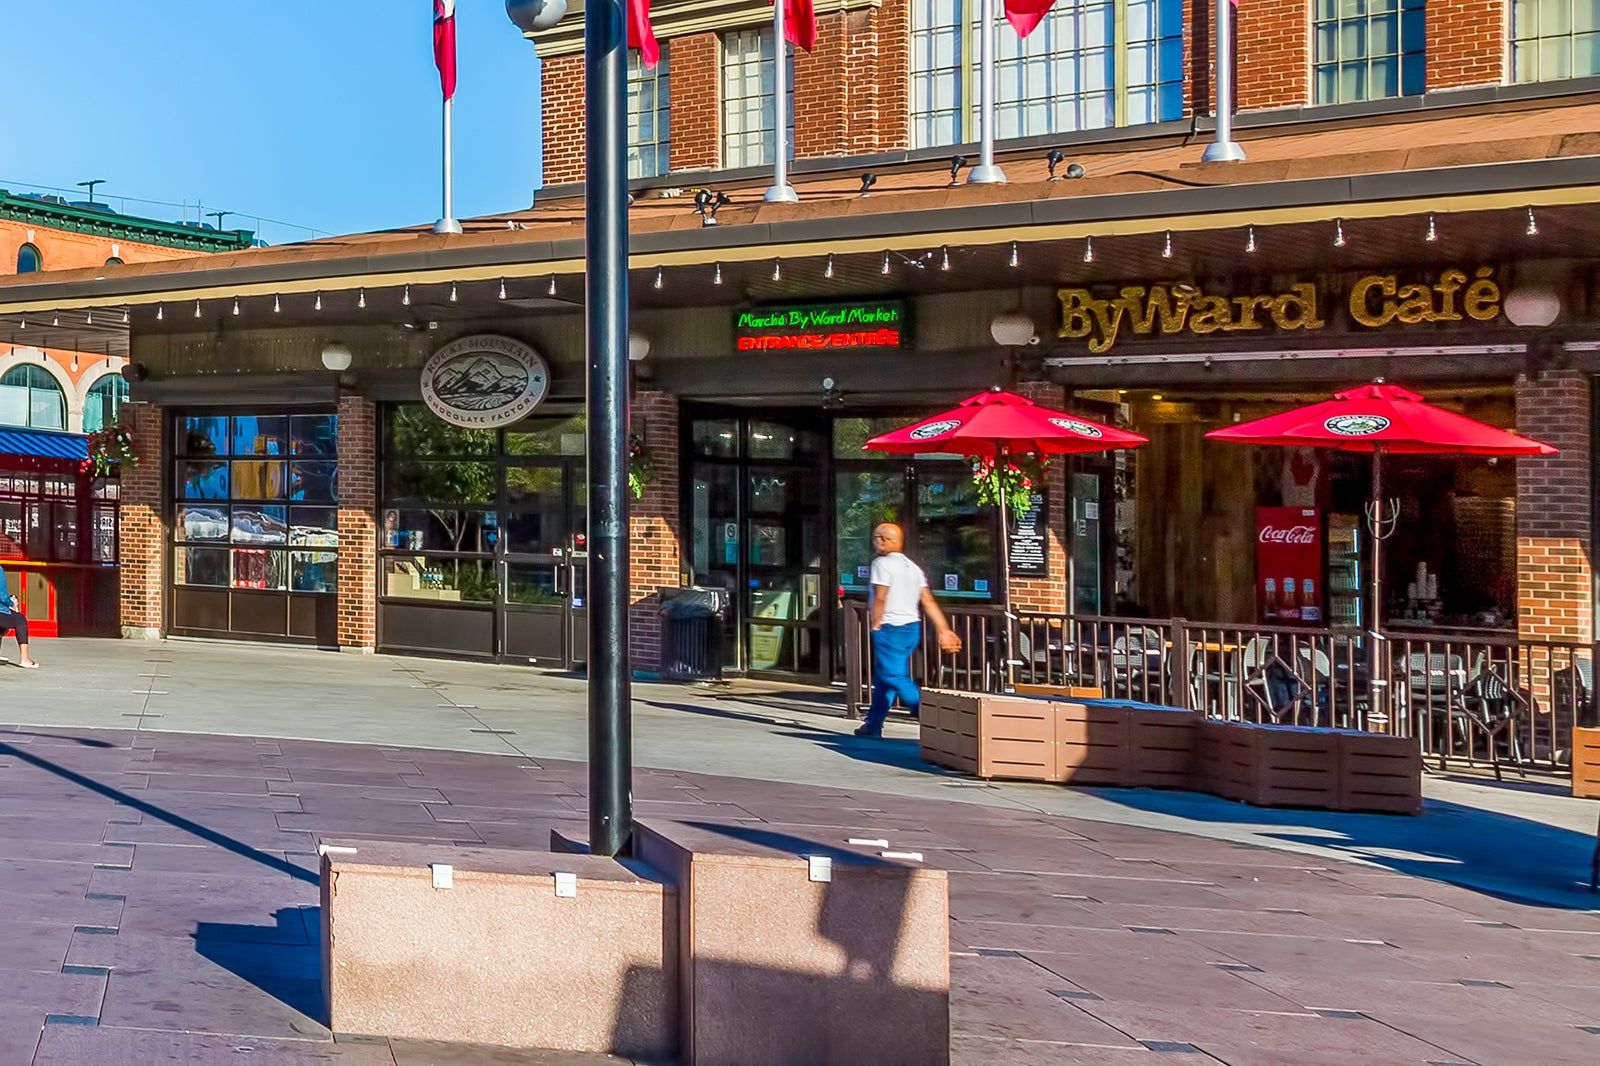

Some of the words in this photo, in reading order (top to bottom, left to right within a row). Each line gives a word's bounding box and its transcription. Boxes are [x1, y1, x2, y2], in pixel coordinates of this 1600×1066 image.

[848, 307, 898, 324] Market
[1057, 283, 1325, 353] ByWard
[1349, 267, 1501, 327] Café
[428, 395, 486, 423] CHOCOLATE
[491, 392, 536, 421] FACTORY
